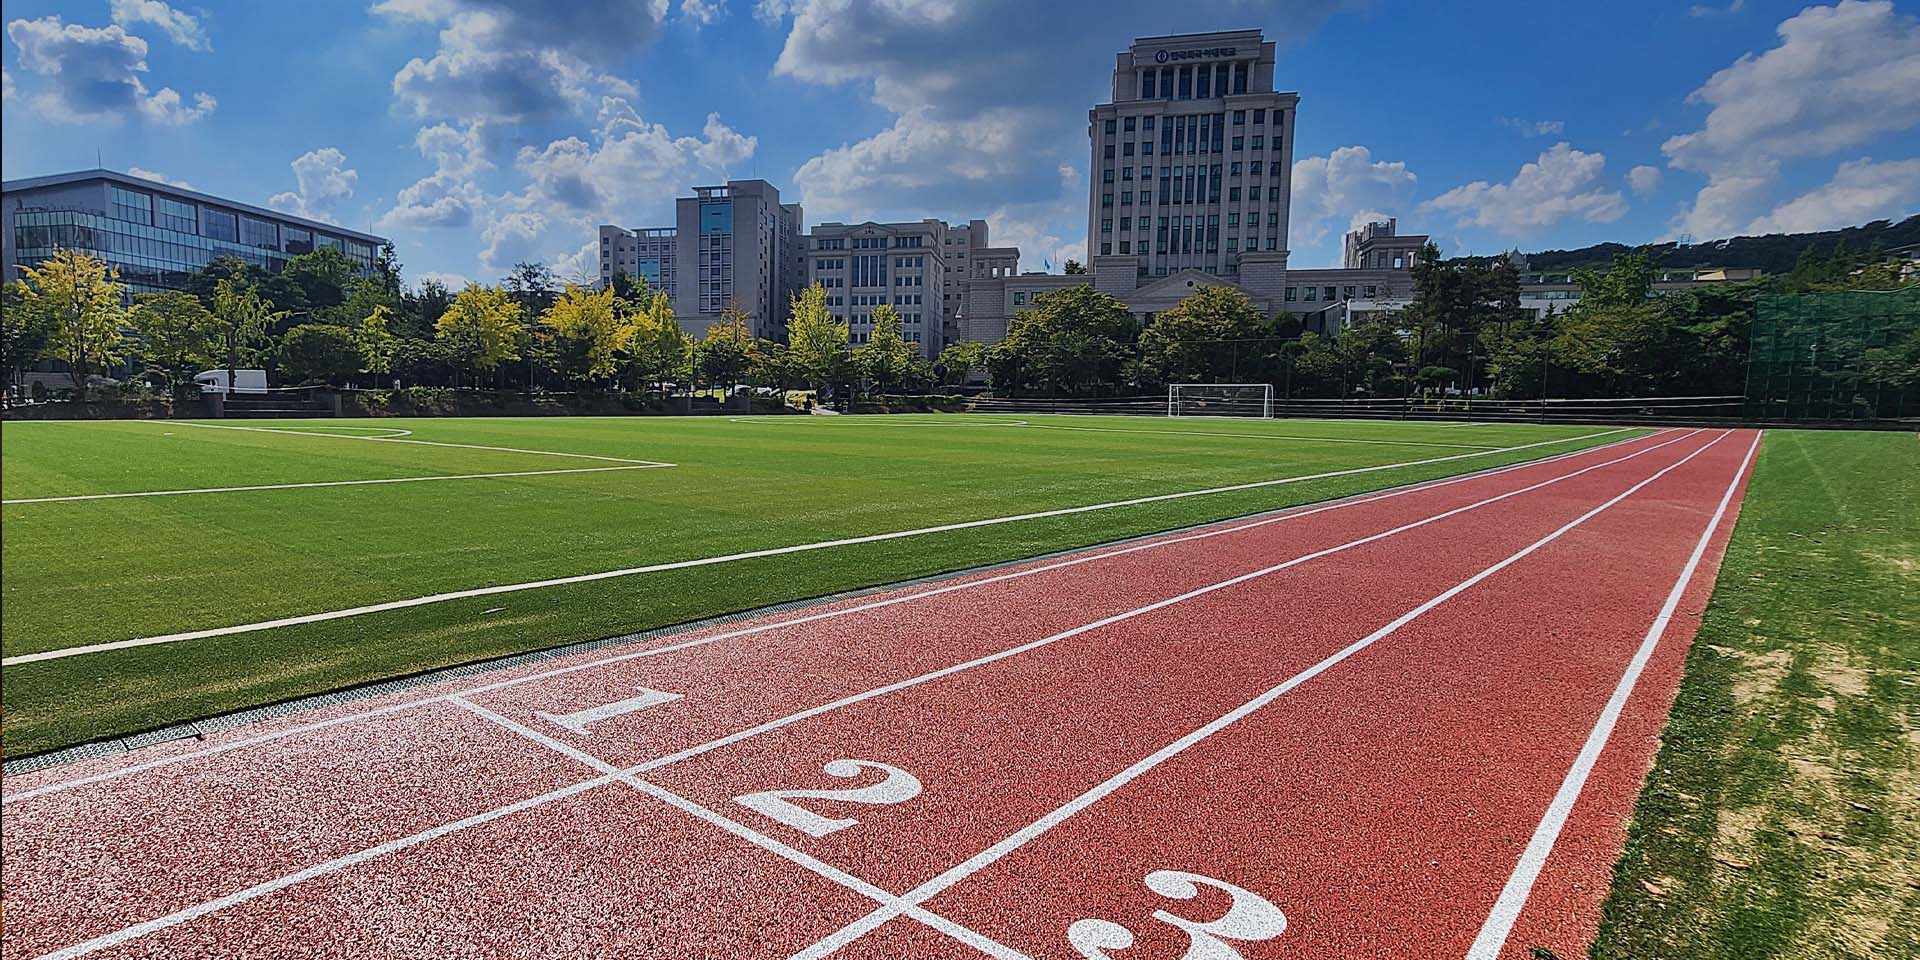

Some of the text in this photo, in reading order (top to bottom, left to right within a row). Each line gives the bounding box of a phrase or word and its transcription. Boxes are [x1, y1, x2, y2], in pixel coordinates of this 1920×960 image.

[536, 686, 686, 736] 1
[733, 758, 922, 838] 2
[1067, 870, 1288, 960] 3
